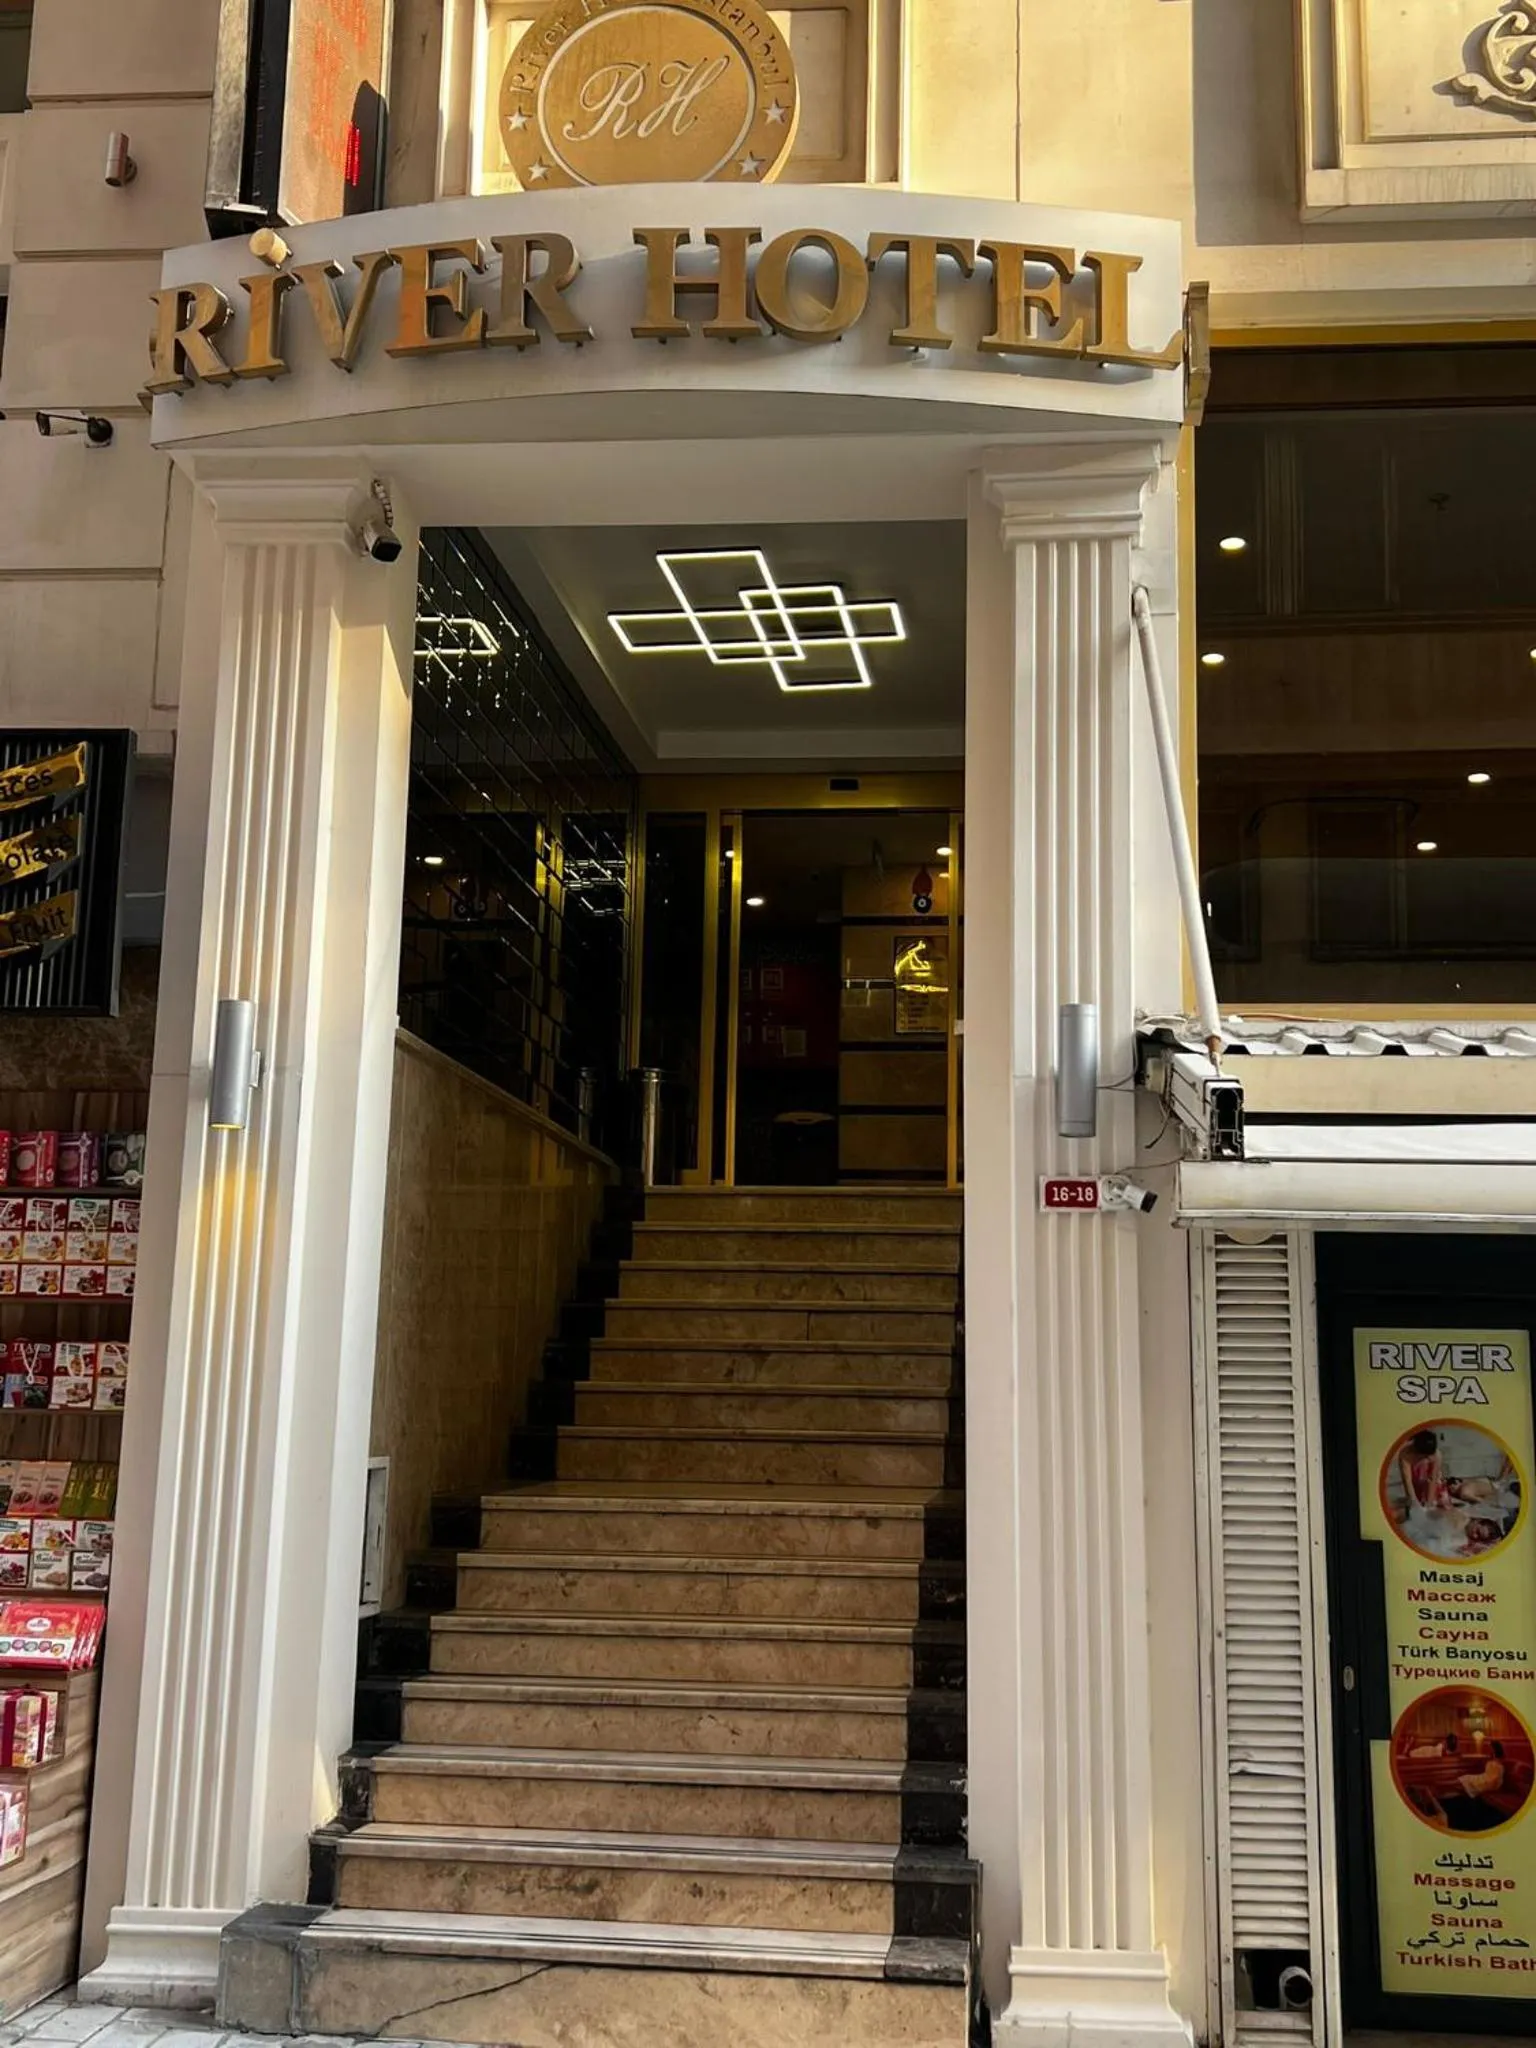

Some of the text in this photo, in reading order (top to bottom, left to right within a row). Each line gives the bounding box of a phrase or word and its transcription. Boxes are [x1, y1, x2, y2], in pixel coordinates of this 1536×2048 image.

[631, 227, 1184, 371] HOTEL
[1052, 1186, 1094, 1202] 16-18
[1369, 1342, 1514, 1371] RIVER
[1397, 1376, 1489, 1404] SPA
[1419, 1570, 1484, 1587] Masaj
[1407, 1588, 1497, 1603] Массаж
[1417, 1607, 1489, 1622] Sauna
[1418, 1626, 1490, 1643] Сауна
[1397, 1644, 1528, 1663] Türk Banyosu
[1391, 1664, 1535, 1680] Турецкие Бани
[1434, 1852, 1495, 1872] تدليك
[1413, 1872, 1517, 1891] Massage
[1433, 1890, 1499, 1910] ساونا
[1430, 1913, 1505, 1929] Sauna
[1406, 1930, 1531, 1952] حمام تركي
[1396, 1951, 1482, 1968] Turkish
